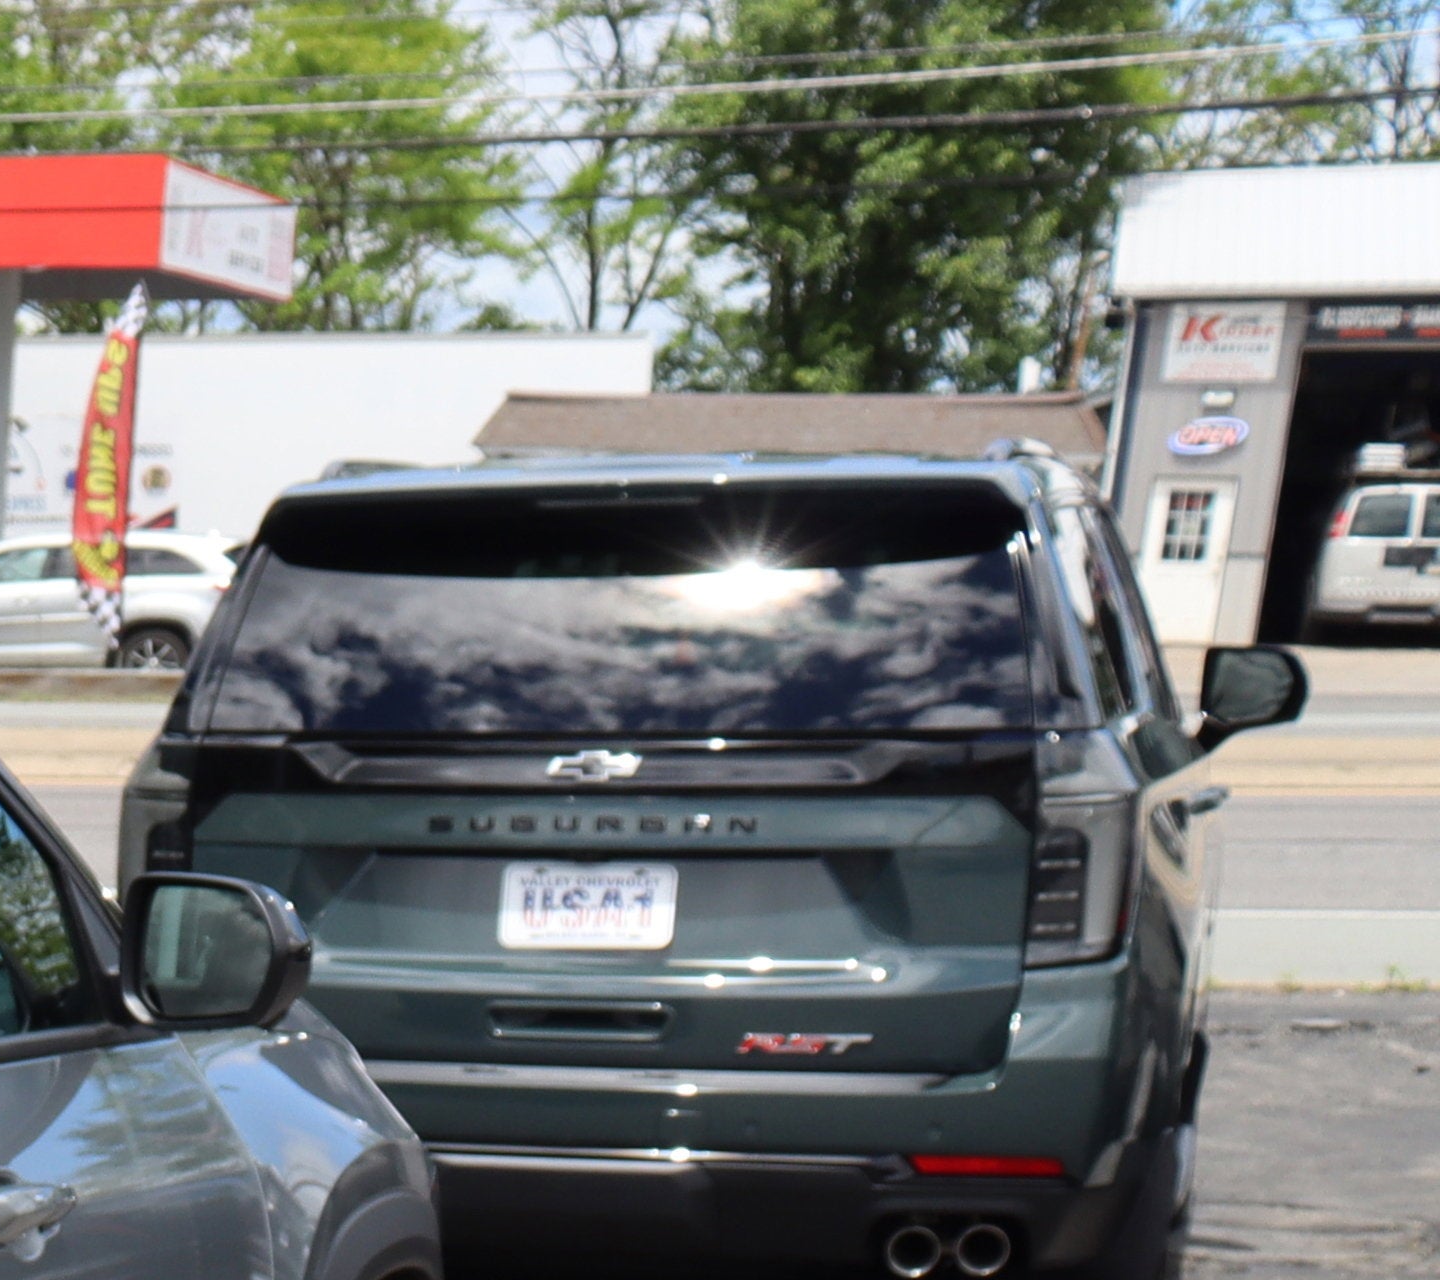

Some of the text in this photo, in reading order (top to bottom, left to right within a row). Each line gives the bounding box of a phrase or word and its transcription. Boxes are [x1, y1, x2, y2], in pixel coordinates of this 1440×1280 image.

[1179, 425, 1238, 446] OPEN
[426, 813, 760, 835] SUBURBAN
[735, 1031, 874, 1056] RST
